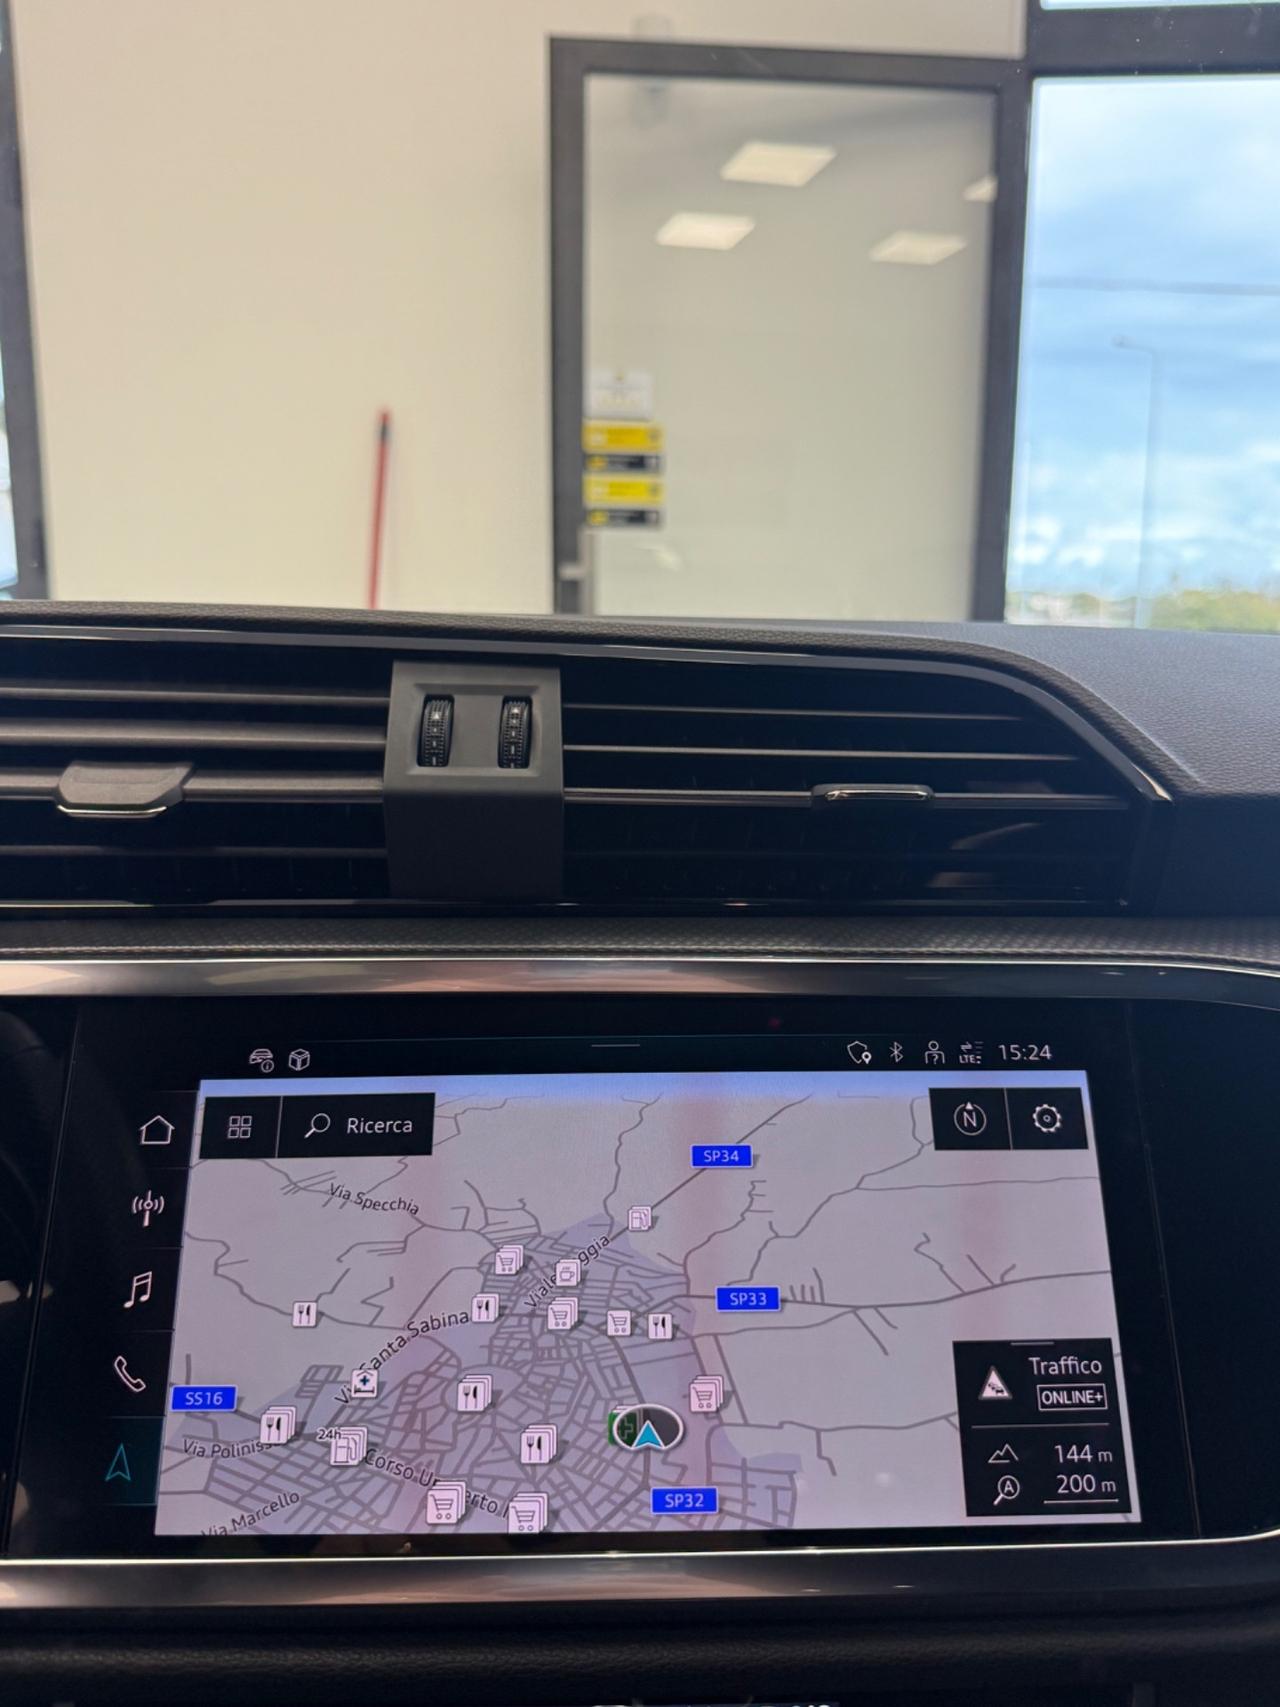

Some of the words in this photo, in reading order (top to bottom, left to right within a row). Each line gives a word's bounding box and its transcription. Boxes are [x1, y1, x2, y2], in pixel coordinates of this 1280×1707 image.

[998, 1044, 1052, 1060] 15:24
[347, 1117, 413, 1134] Ricerca
[963, 1111, 977, 1127] N
[703, 1149, 740, 1162] SP34
[329, 1182, 352, 1201] Via
[353, 1191, 420, 1215] Specchia
[574, 1235, 610, 1266] ggia
[729, 1291, 768, 1306] SP33
[406, 1311, 470, 1338] Sabina
[1028, 1356, 1103, 1375] Traffico
[185, 1391, 224, 1406] SS16
[1041, 1390, 1104, 1405] ONLINE+
[318, 1427, 342, 1440] 24h
[183, 1439, 207, 1458] Via
[1054, 1444, 1093, 1463] 144
[1097, 1450, 1113, 1463] m
[364, 1448, 415, 1481] Corso
[419, 1468, 498, 1514] Uerto
[1056, 1474, 1096, 1494] 200
[1101, 1480, 1117, 1493] m
[664, 1493, 704, 1508] SP32
[231, 1492, 301, 1533] Marcello
